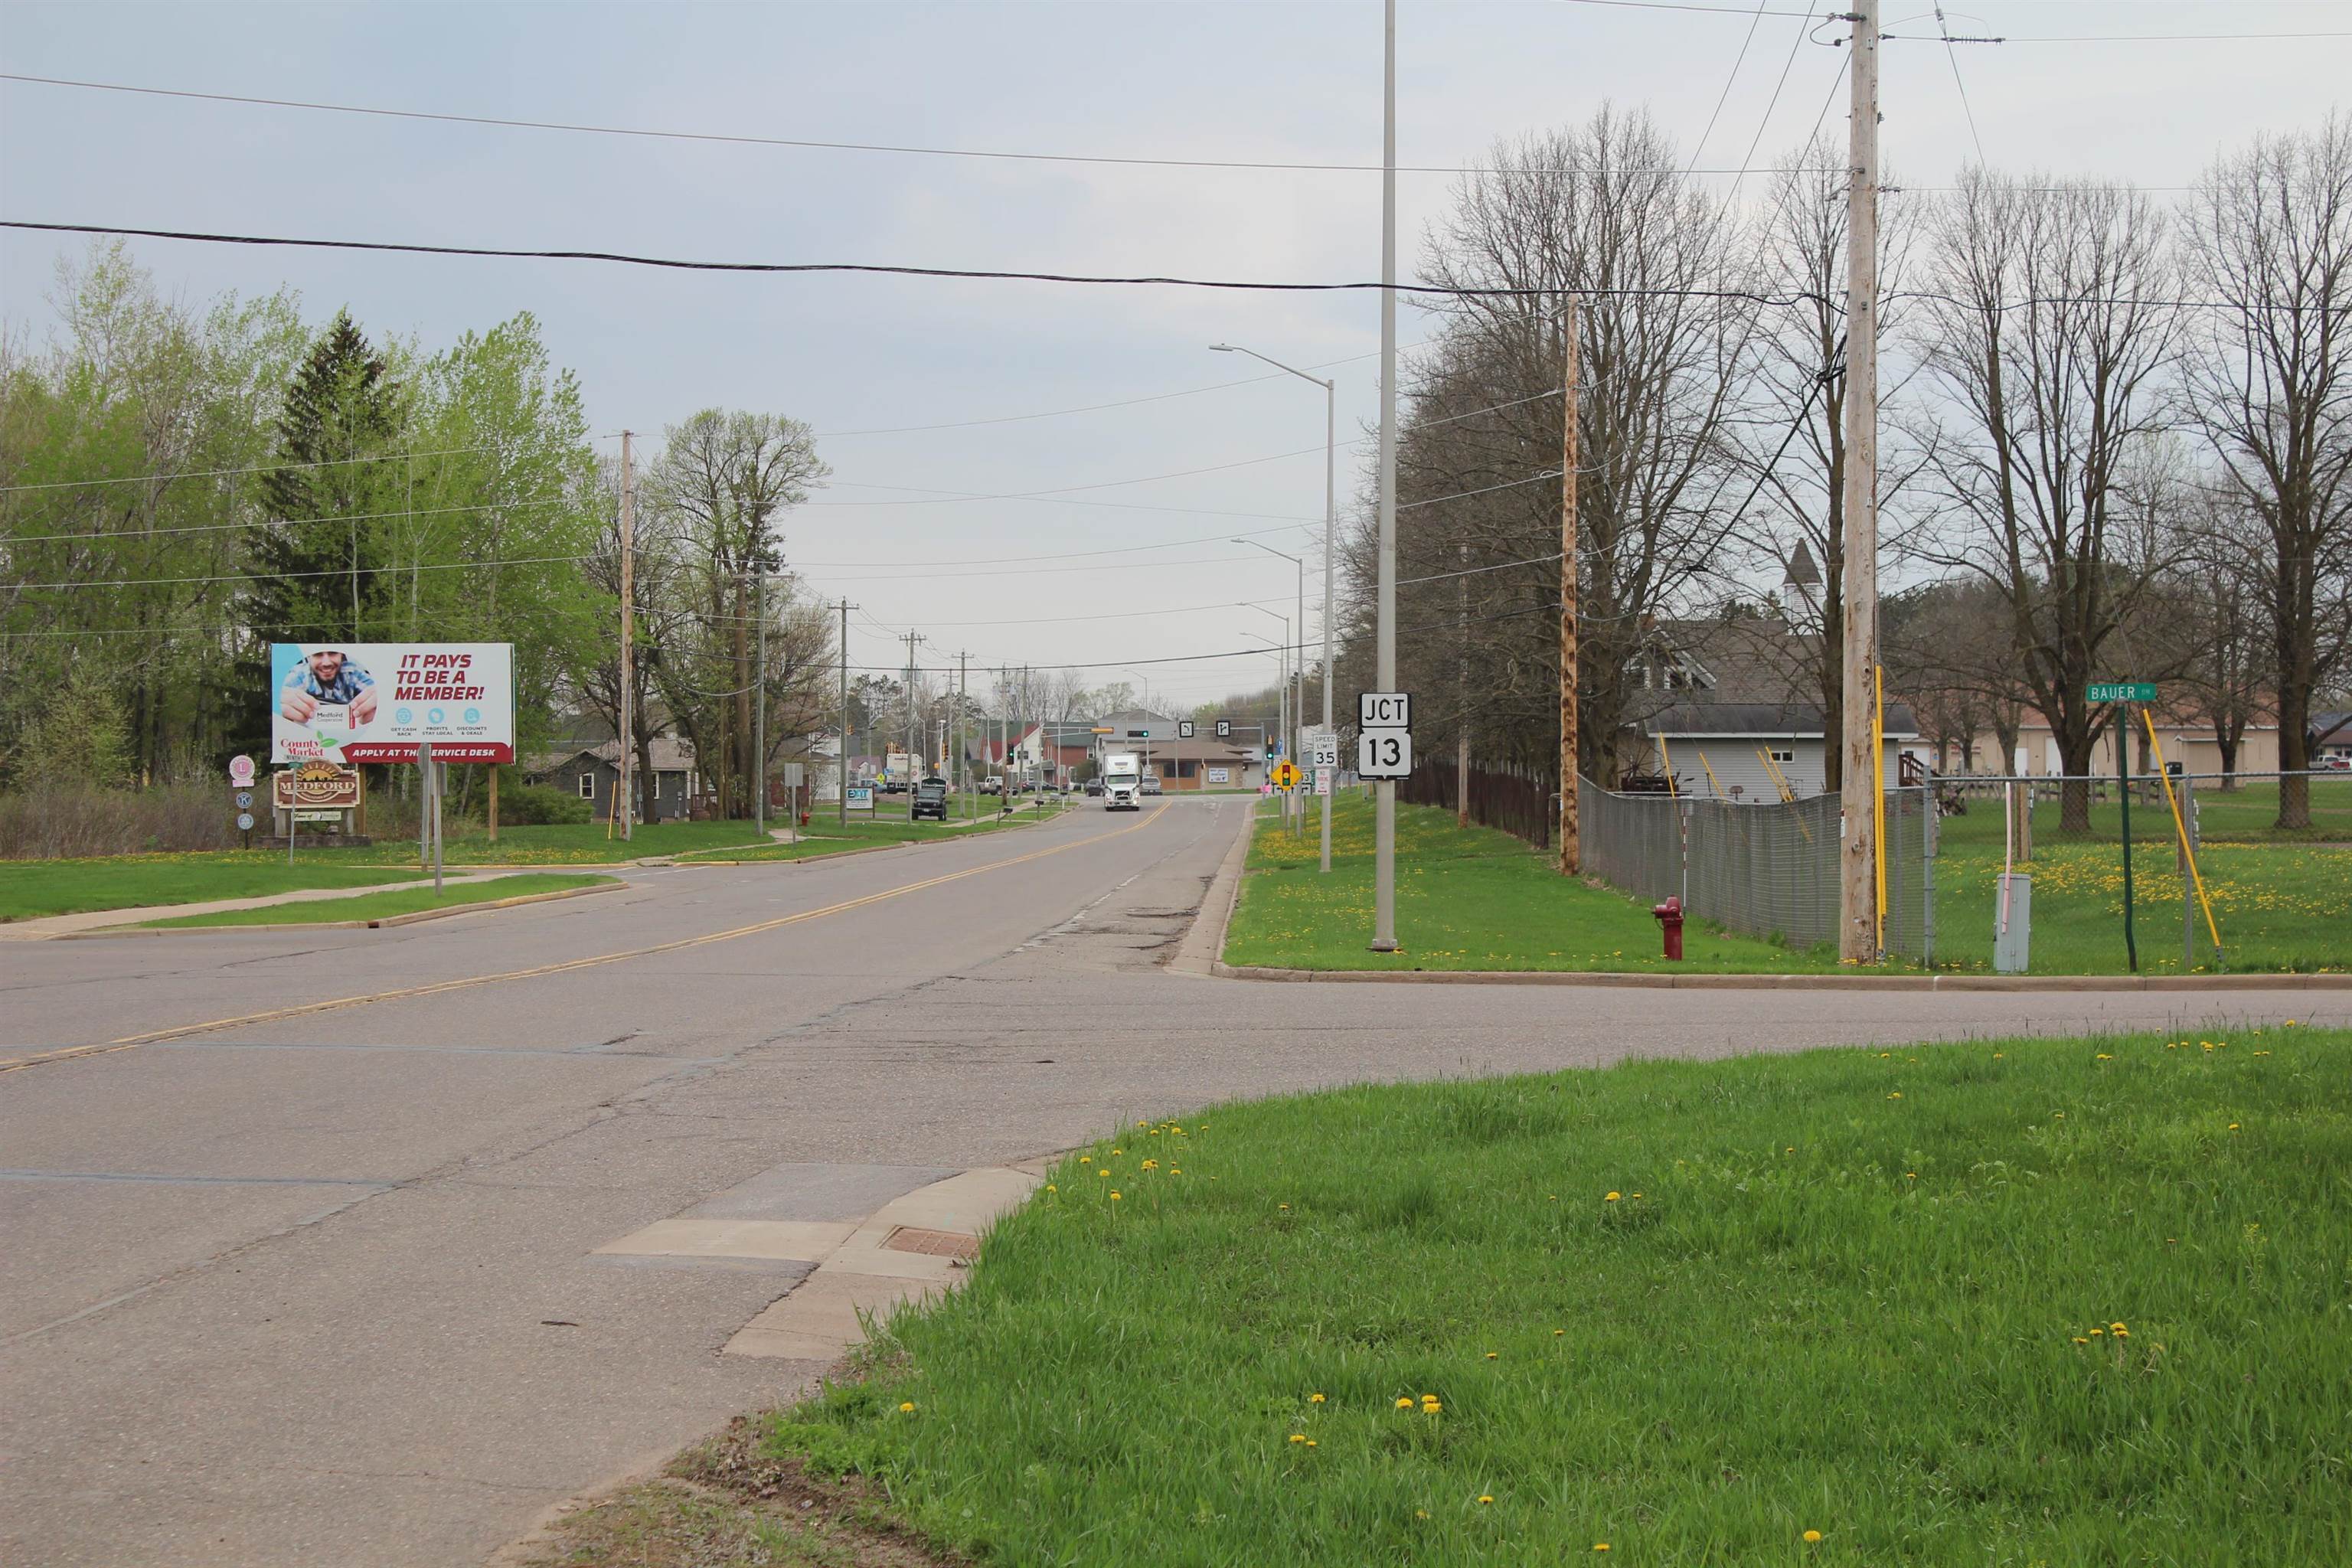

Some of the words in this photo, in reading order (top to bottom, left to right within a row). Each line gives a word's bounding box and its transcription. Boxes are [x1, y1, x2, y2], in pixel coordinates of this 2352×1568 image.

[401, 655, 420, 668] IT
[423, 655, 472, 668] PAYS
[397, 671, 420, 684] TO
[424, 671, 449, 684] BE
[452, 671, 466, 684] A
[394, 687, 484, 700] MEMBER!
[2092, 687, 2135, 699] BAUER
[1365, 698, 1404, 720] JCT
[280, 738, 319, 750] County
[288, 747, 325, 756] Market
[1369, 738, 1400, 766] 13
[1316, 752, 1334, 764] 35
[280, 782, 355, 790] MEDFORD
